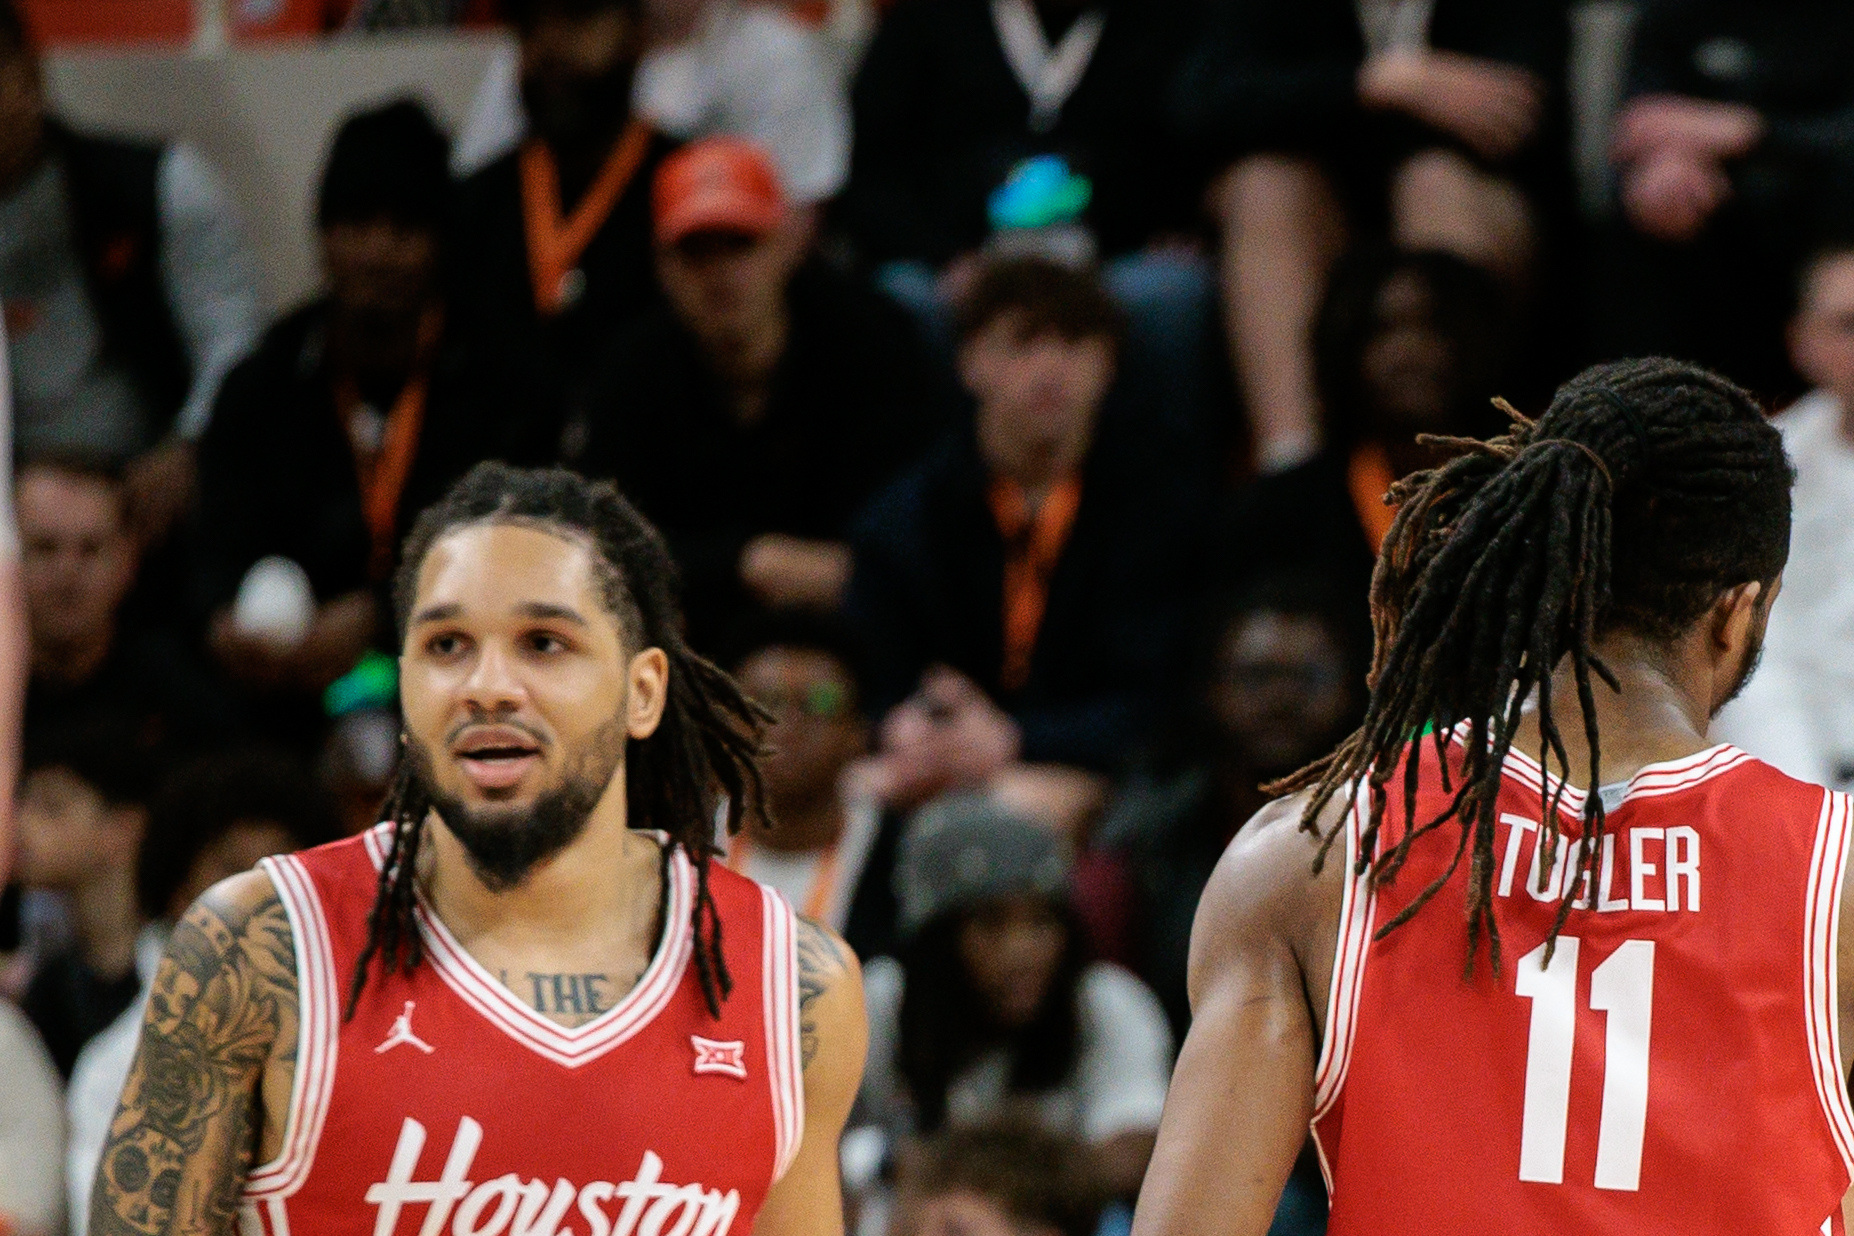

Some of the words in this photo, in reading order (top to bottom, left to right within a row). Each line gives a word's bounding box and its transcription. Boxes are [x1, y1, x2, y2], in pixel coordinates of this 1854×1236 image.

[1497, 812, 1701, 912] TUGLER
[527, 971, 613, 1015] THE
[1515, 934, 1656, 1192] 11
